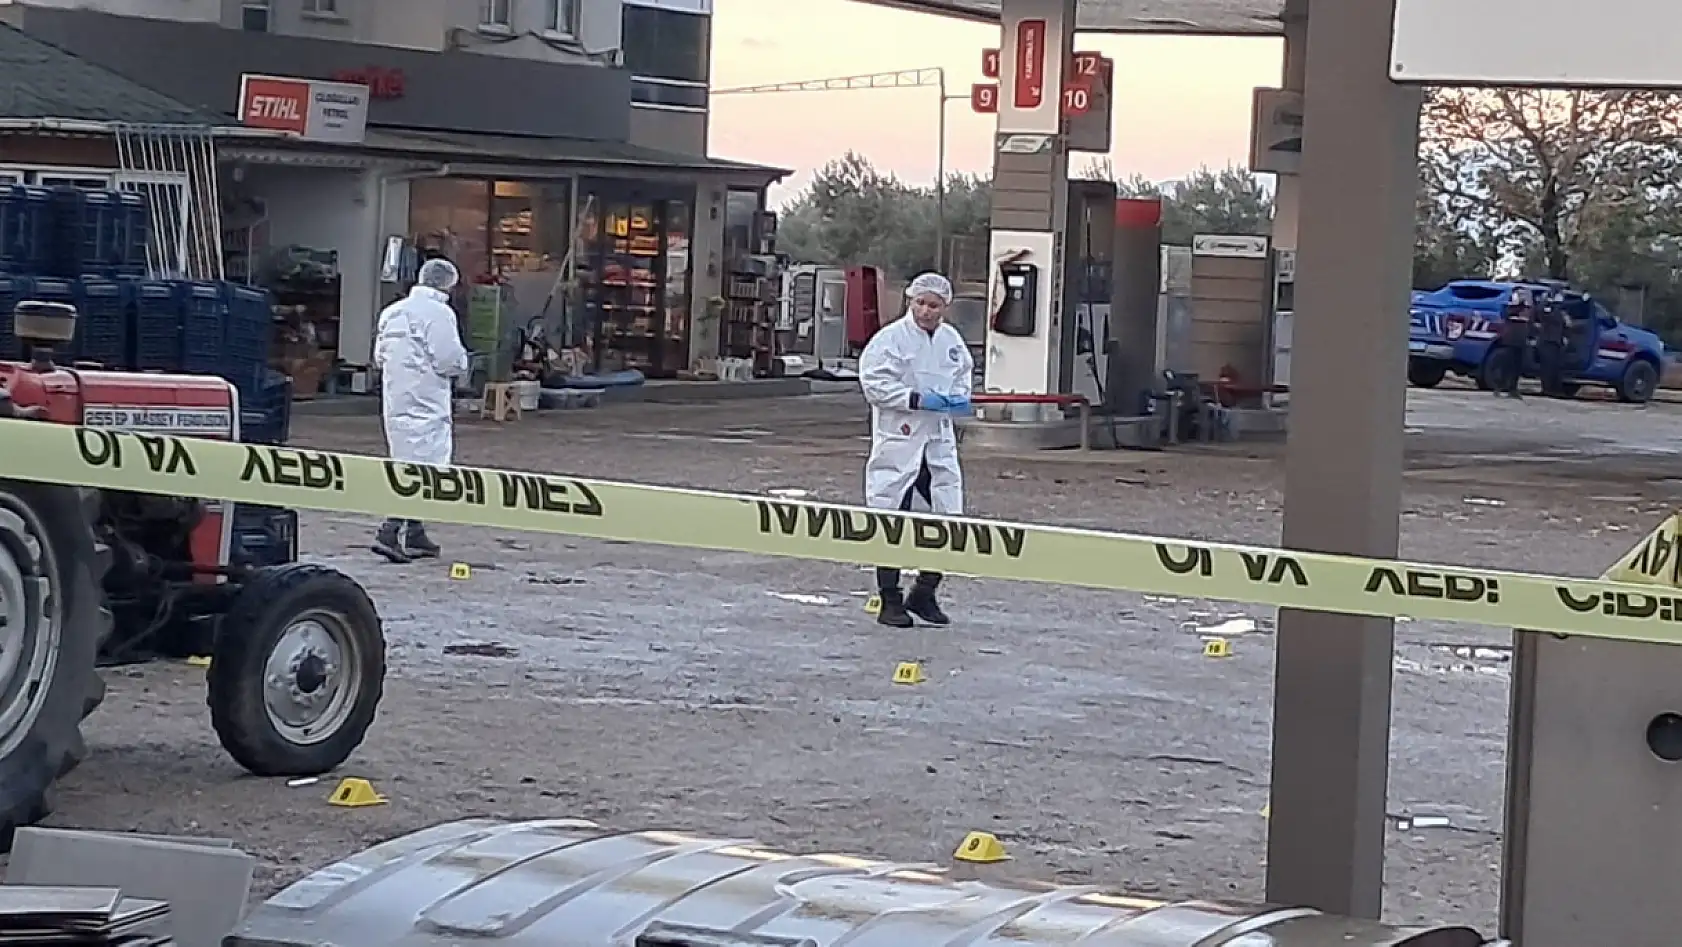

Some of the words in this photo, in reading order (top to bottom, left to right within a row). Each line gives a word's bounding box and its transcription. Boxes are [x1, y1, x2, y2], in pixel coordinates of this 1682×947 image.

[1075, 57, 1097, 74] 12
[980, 89, 992, 107] 9
[1064, 90, 1088, 109] 10
[250, 96, 300, 120] STIHL
[968, 838, 980, 851] 9
